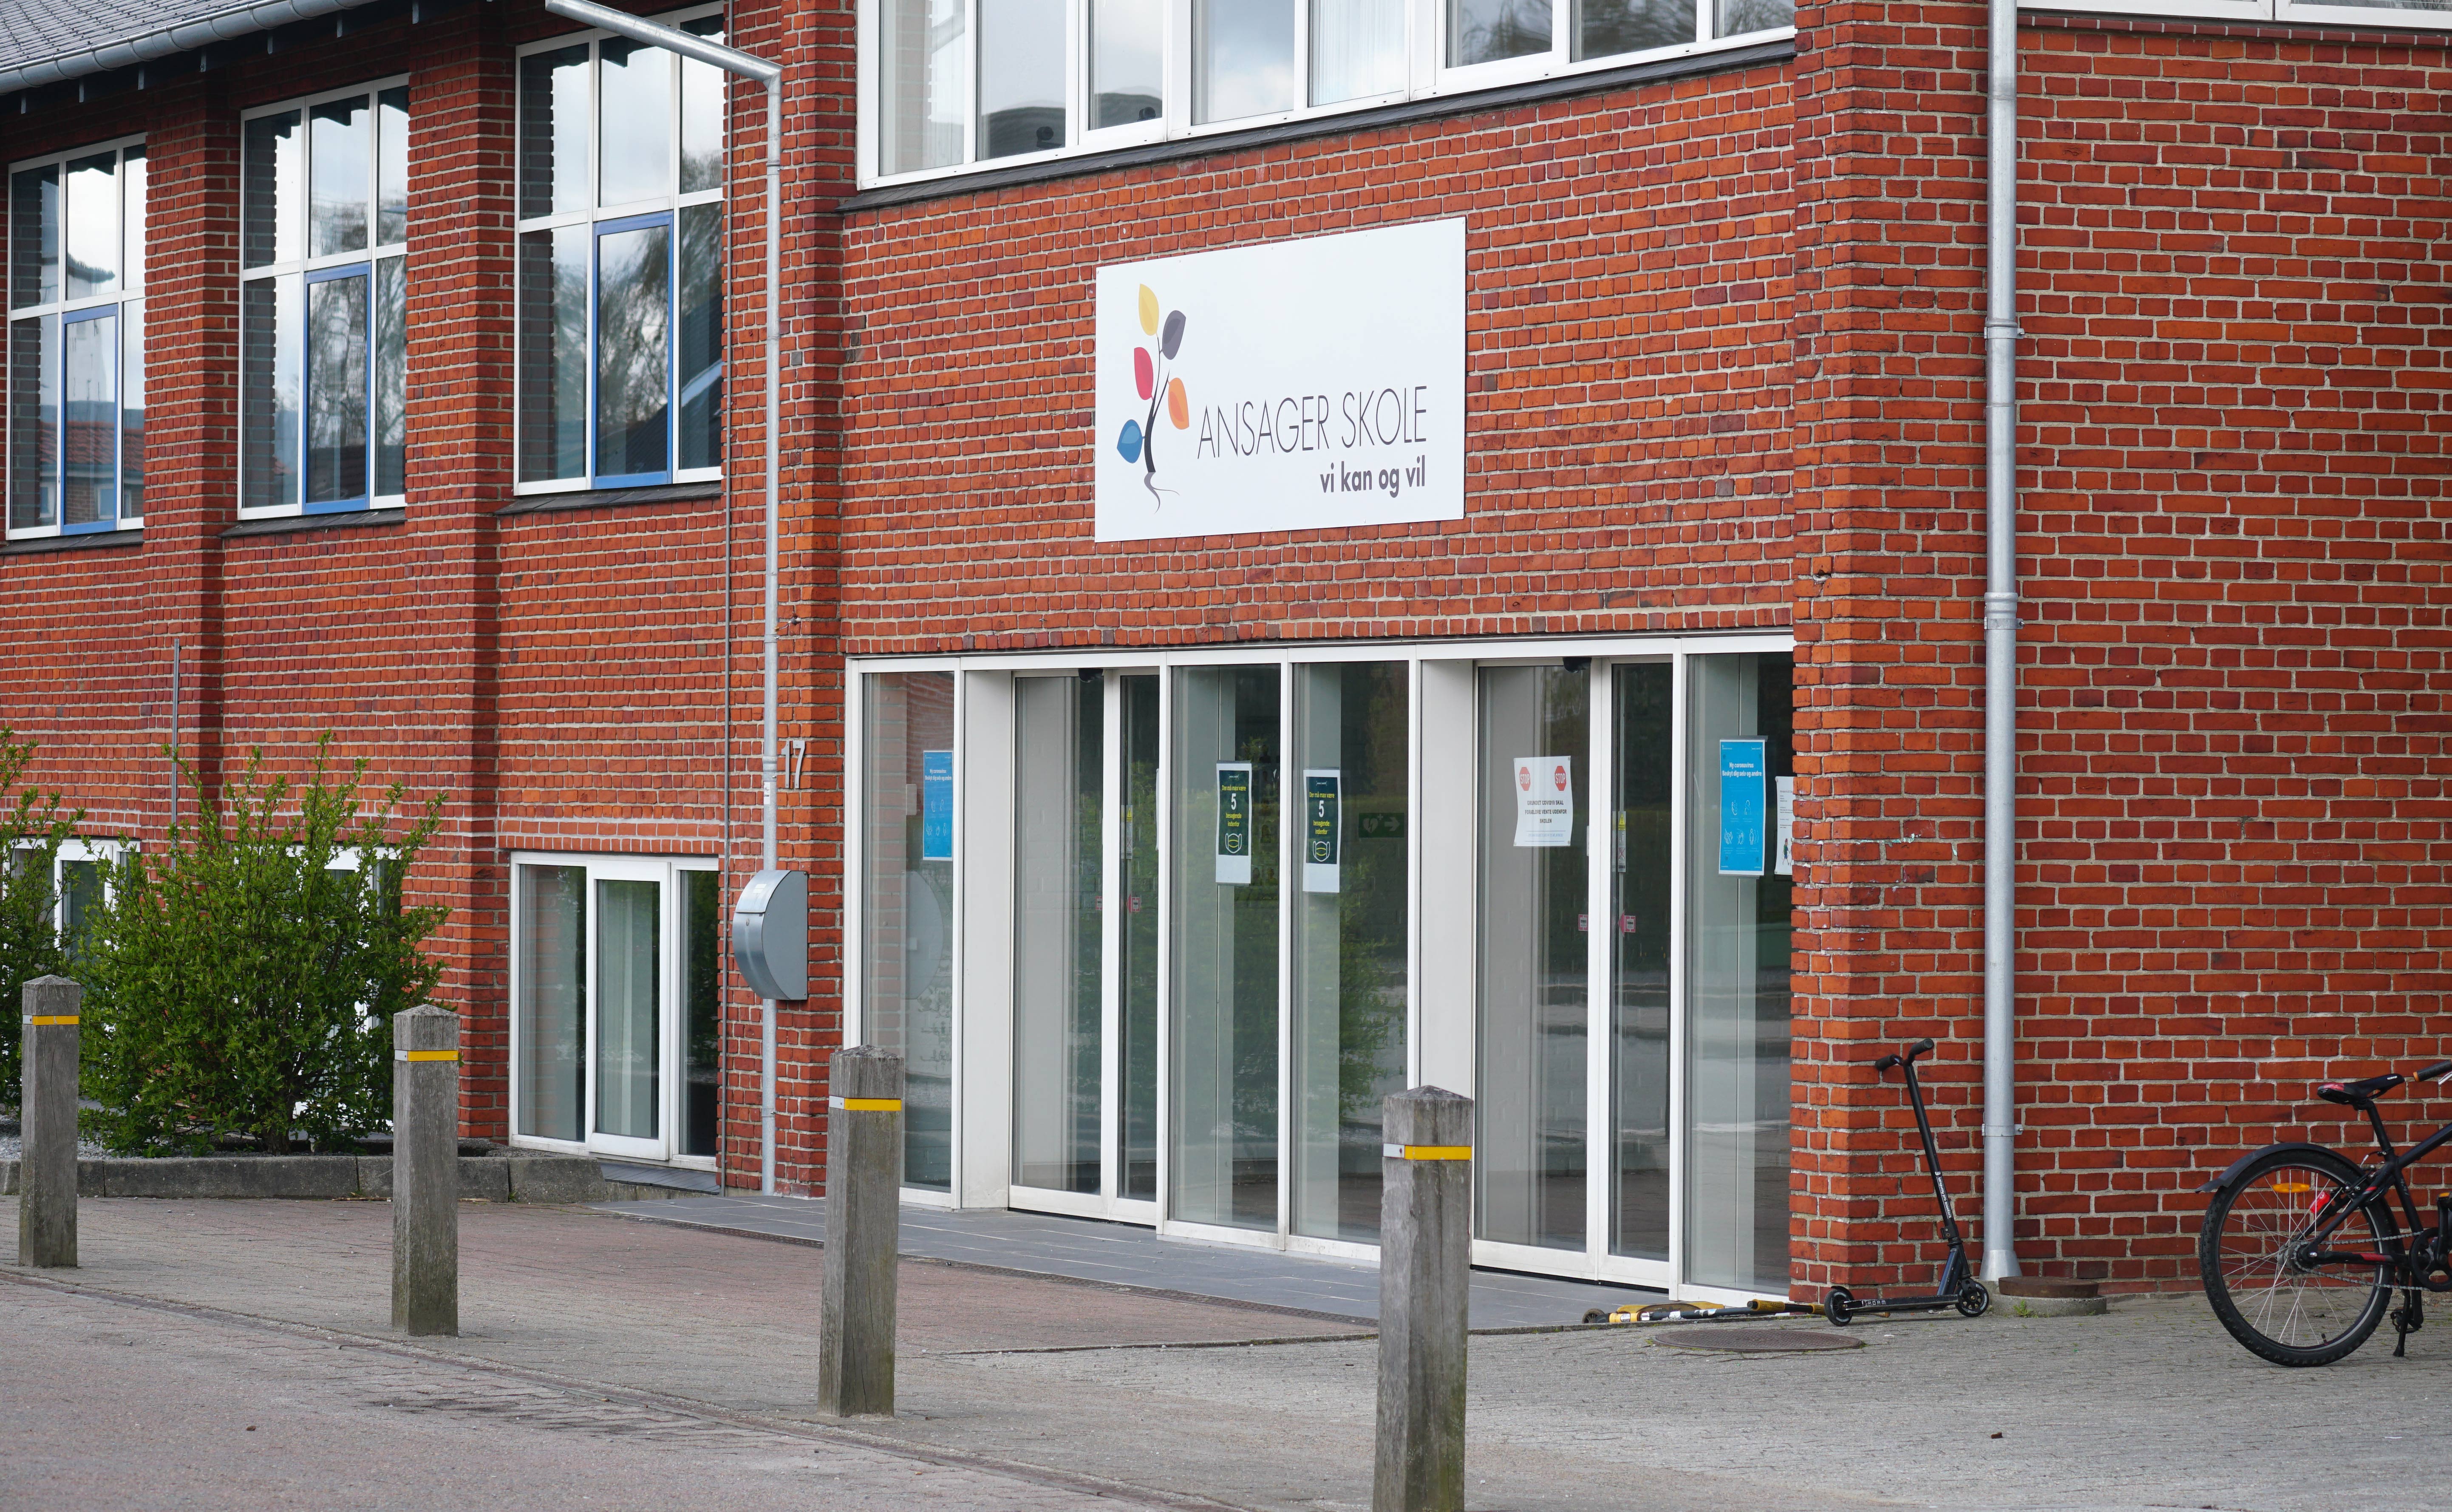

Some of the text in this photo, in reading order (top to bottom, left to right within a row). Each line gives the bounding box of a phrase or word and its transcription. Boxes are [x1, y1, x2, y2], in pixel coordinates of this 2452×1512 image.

[1197, 386, 1427, 459] ANSAGER SKOLE
[1320, 455, 1425, 498] vi kan og vil
[781, 740, 805, 789] 17
[1520, 773, 1530, 784] STOP
[1555, 773, 1566, 784] STOP
[1231, 793, 1237, 810] 5
[1319, 800, 1324, 818] 5
